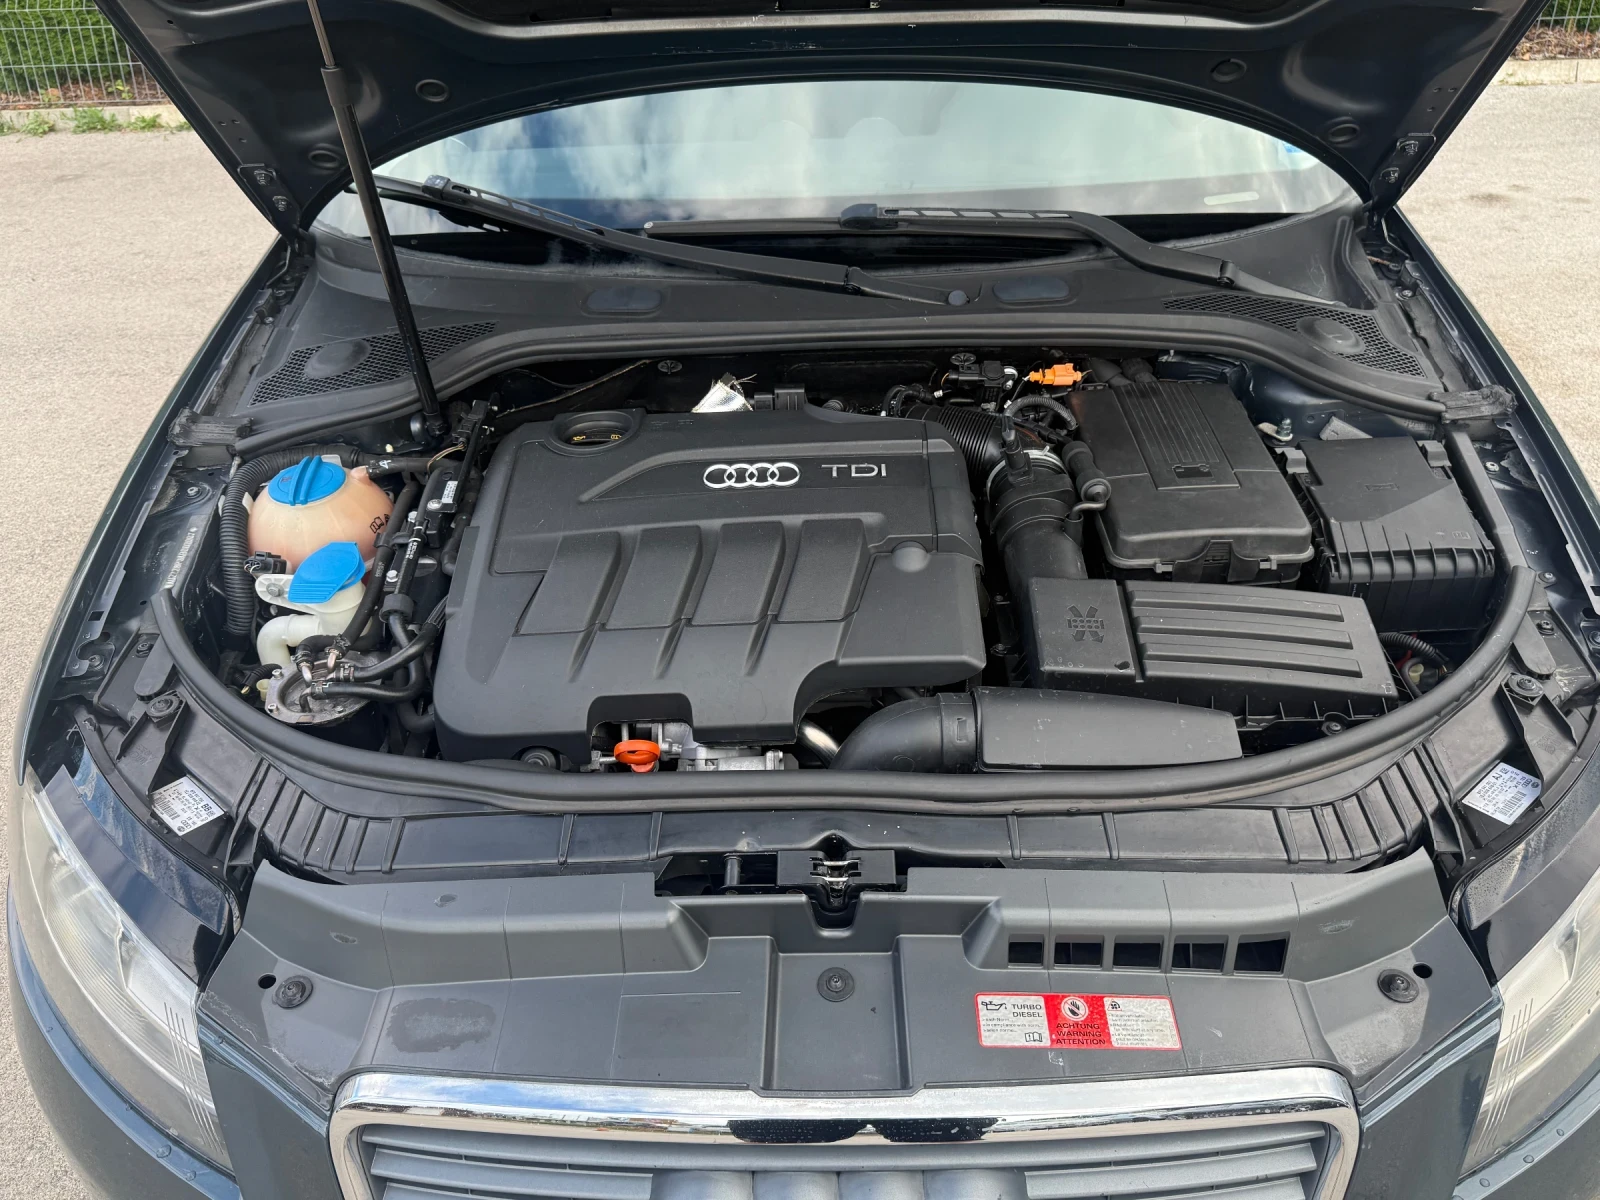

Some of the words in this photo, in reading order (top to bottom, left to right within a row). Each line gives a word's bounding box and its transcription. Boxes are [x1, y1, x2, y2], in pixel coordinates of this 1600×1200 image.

[821, 463, 887, 477] TDI
[1056, 1022, 1100, 1030] ACHTUNG
[1056, 1030, 1102, 1038] WARNING
